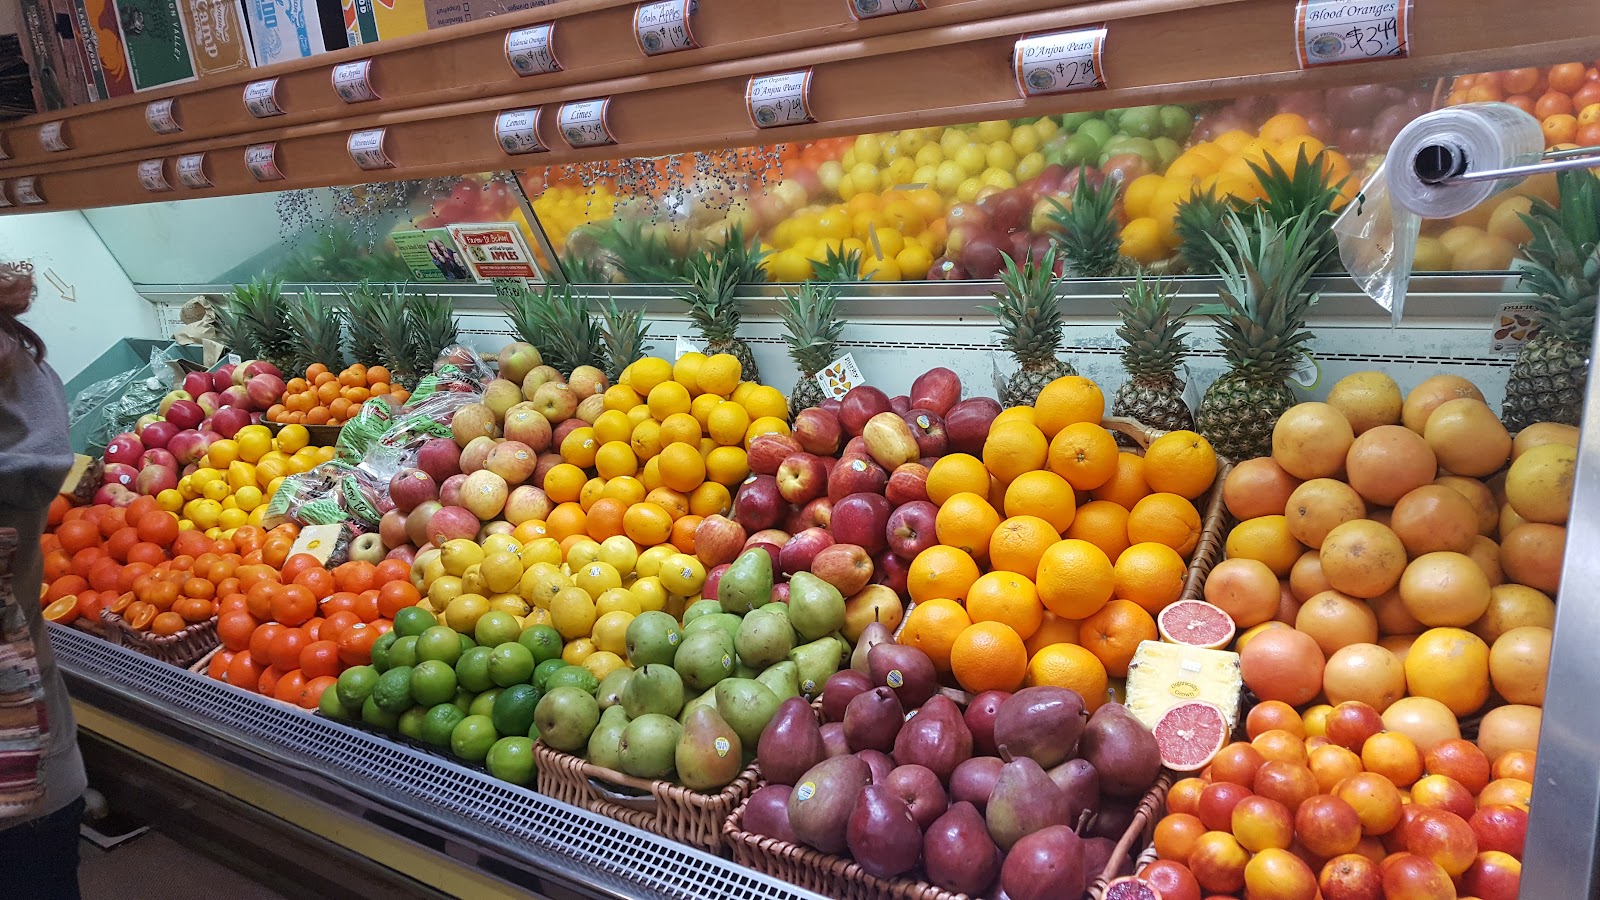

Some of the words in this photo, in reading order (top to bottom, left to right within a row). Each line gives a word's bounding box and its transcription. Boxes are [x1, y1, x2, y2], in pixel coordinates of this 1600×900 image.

[640, 9, 657, 24] Gala
[658, 6, 681, 23] Apples
[1309, 5, 1347, 21] Blood
[1347, 2, 1396, 17] Oranges
[172, 22, 181, 62] VALLEY
[1345, 17, 1397, 56] $3.49
[1025, 44, 1065, 58] D'Anjou
[1066, 41, 1093, 52] Pears
[1055, 58, 1095, 88] $2.29
[752, 86, 782, 97] D'Anjou
[782, 83, 802, 92] Pears
[570, 109, 592, 121] Limes
[505, 119, 527, 128] Lemons
[490, 251, 519, 261] APPLES
[1502, 304, 1540, 312] purity
[1170, 680, 1199, 691] Organically
[1174, 689, 1195, 698] Grown
